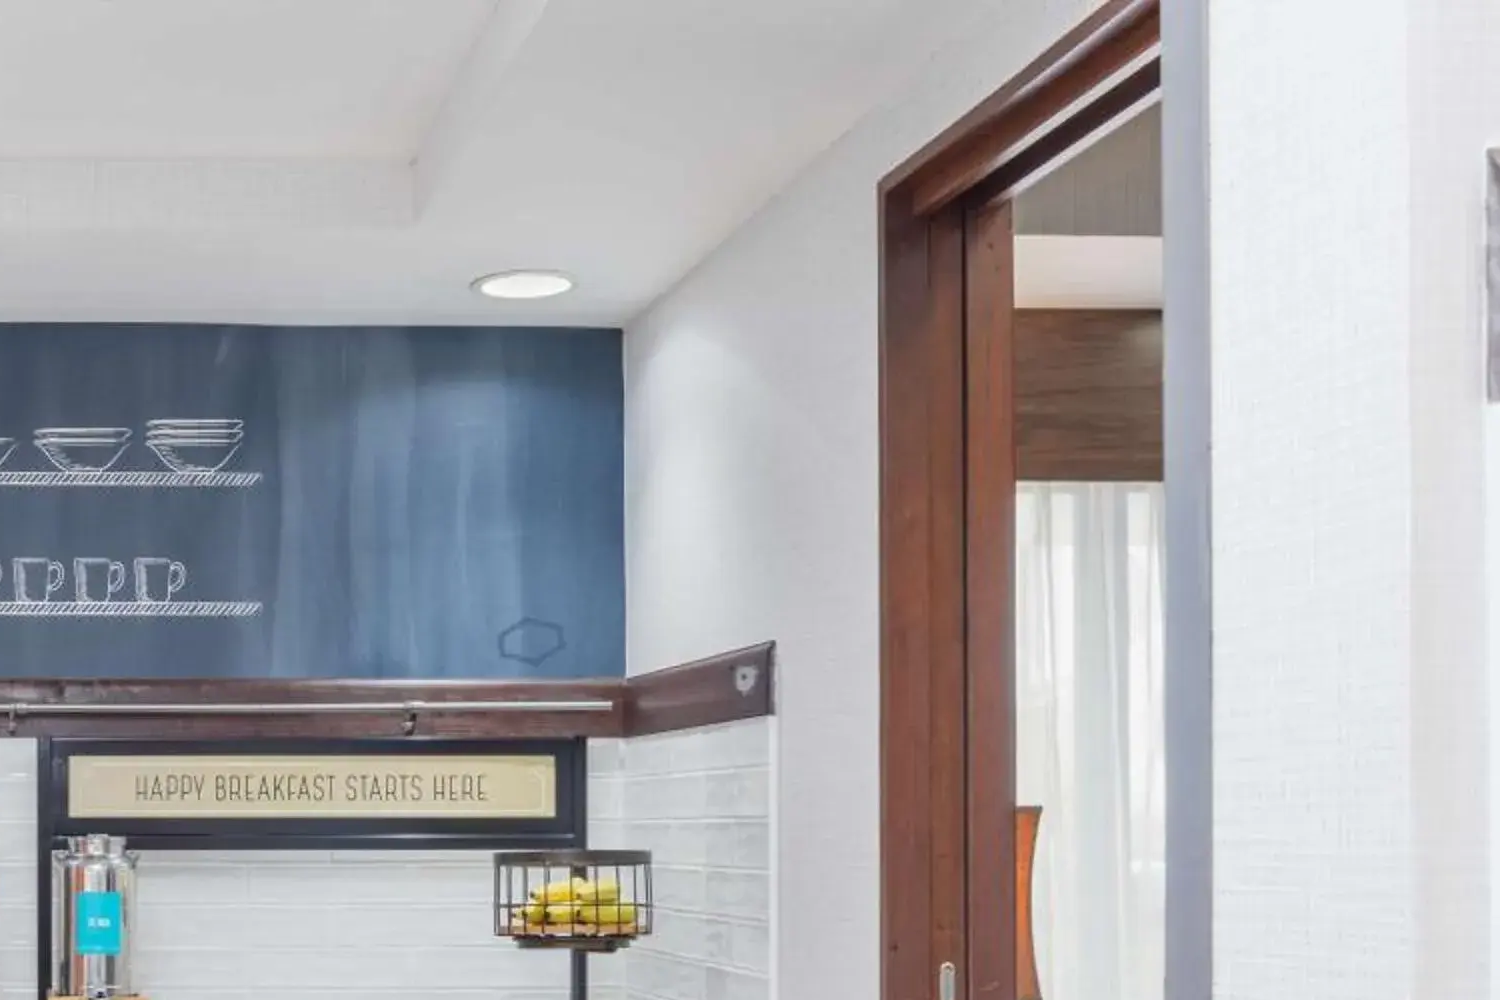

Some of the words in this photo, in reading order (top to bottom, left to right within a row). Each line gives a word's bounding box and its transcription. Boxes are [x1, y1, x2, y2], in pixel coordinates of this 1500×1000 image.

[135, 774, 205, 801] HAPPY
[215, 774, 336, 801] BREAKFAST
[345, 774, 424, 801] STARTS
[433, 774, 489, 801] HERE
